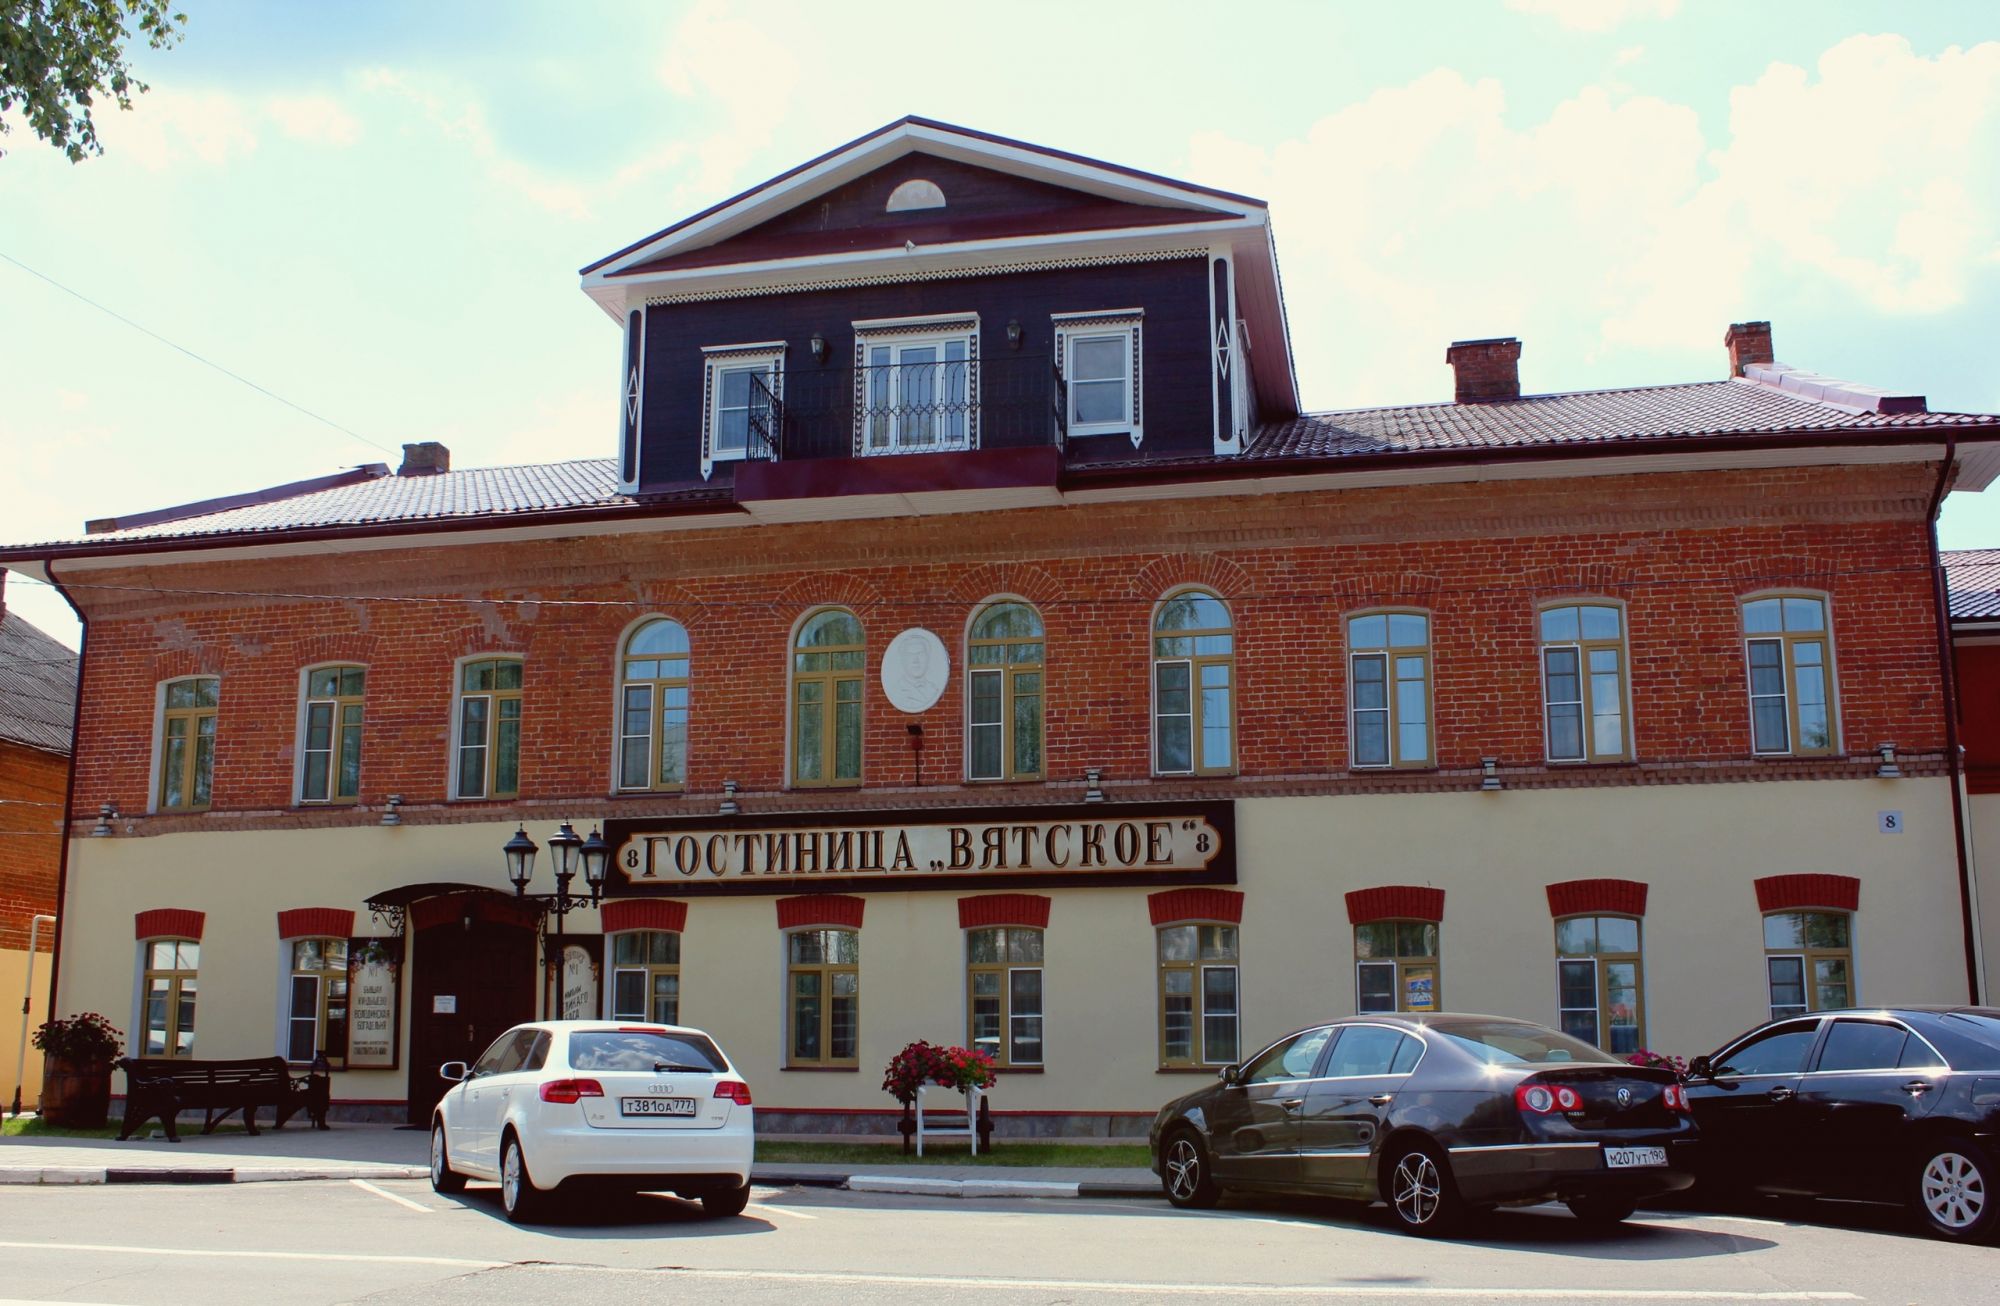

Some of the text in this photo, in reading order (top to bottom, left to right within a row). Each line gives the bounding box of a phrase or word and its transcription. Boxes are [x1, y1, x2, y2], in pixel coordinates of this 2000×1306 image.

[1886, 815, 1896, 828] 8
[627, 849, 639, 868] 8
[642, 829, 918, 878] ГОСТИНИЦА
[1196, 833, 1210, 853] 8
[1649, 1150, 1665, 1161] 190
